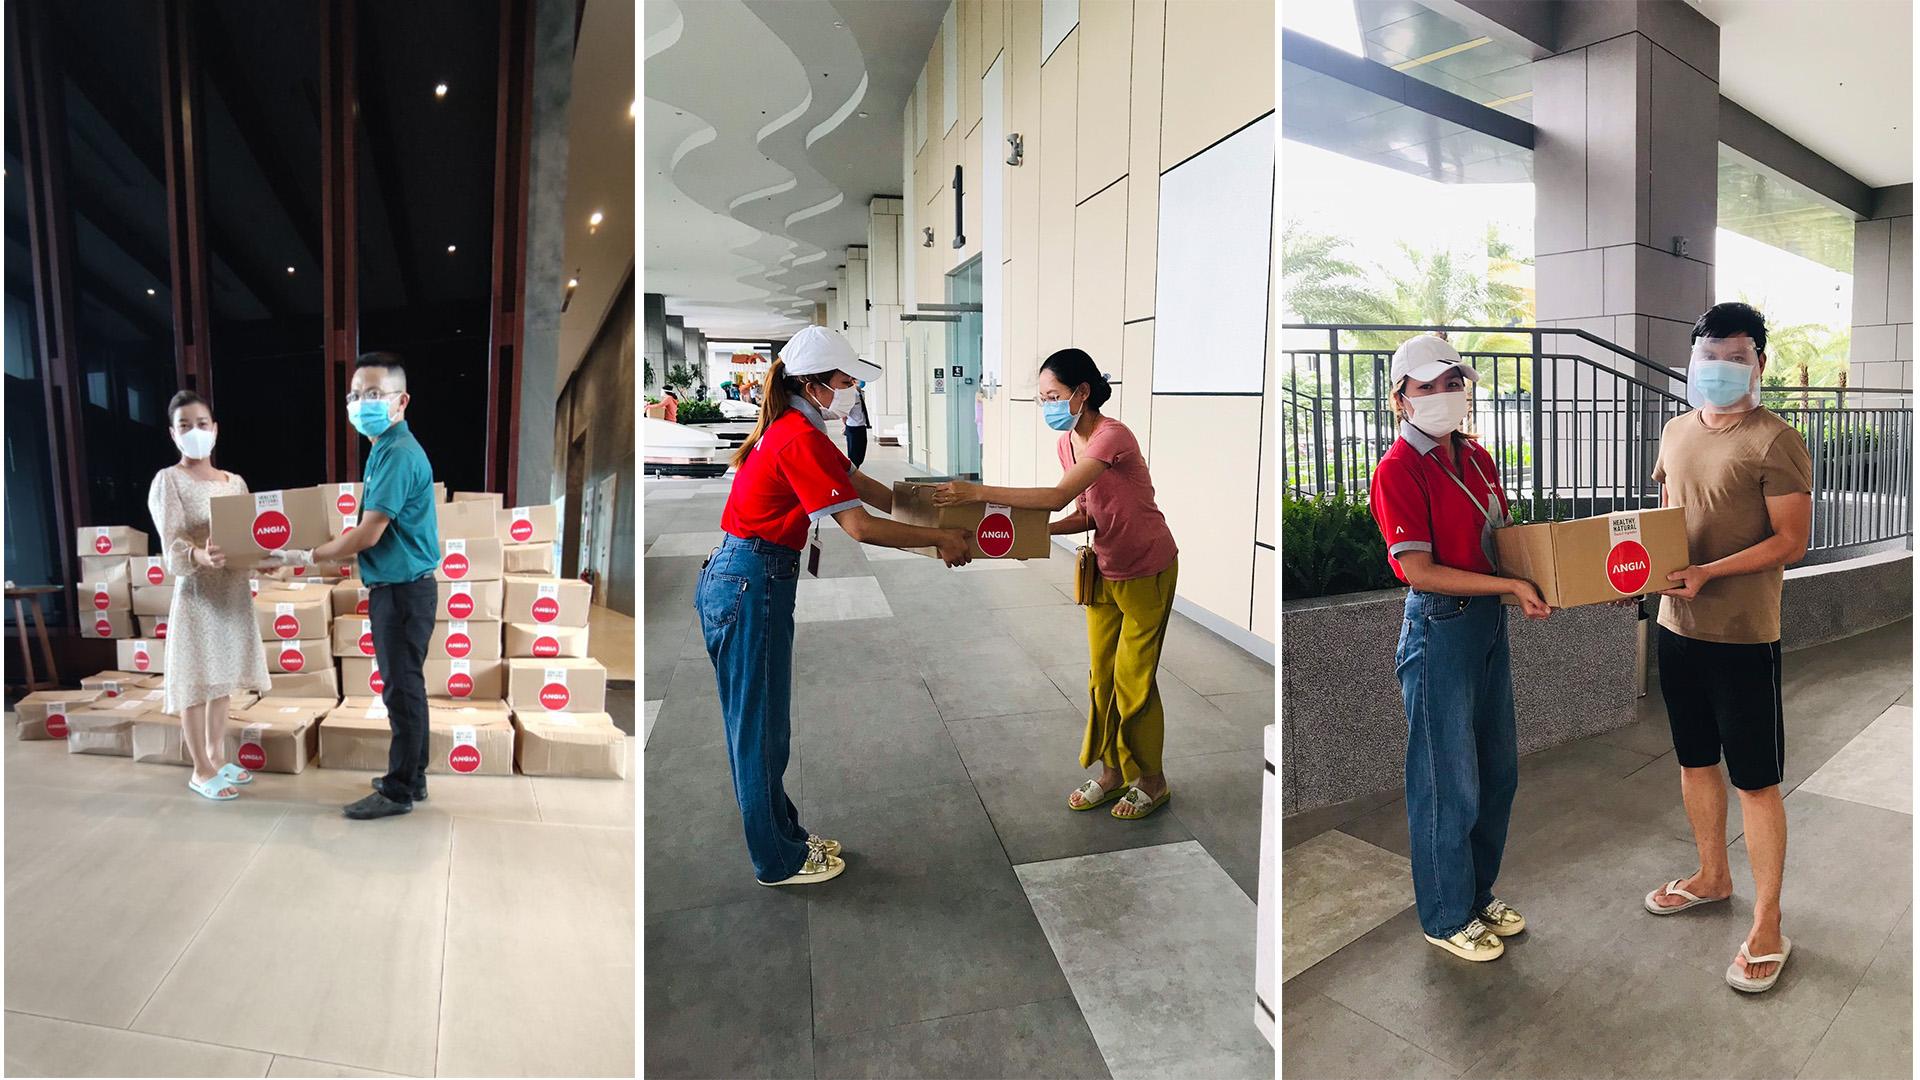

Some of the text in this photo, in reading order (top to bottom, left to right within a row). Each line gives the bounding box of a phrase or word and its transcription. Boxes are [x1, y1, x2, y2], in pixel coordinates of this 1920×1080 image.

[256, 525, 287, 535] ANGIA
[1613, 524, 1637, 532] NATURAL
[981, 531, 1010, 539] ANGIA
[1612, 560, 1646, 574] ANGIA
